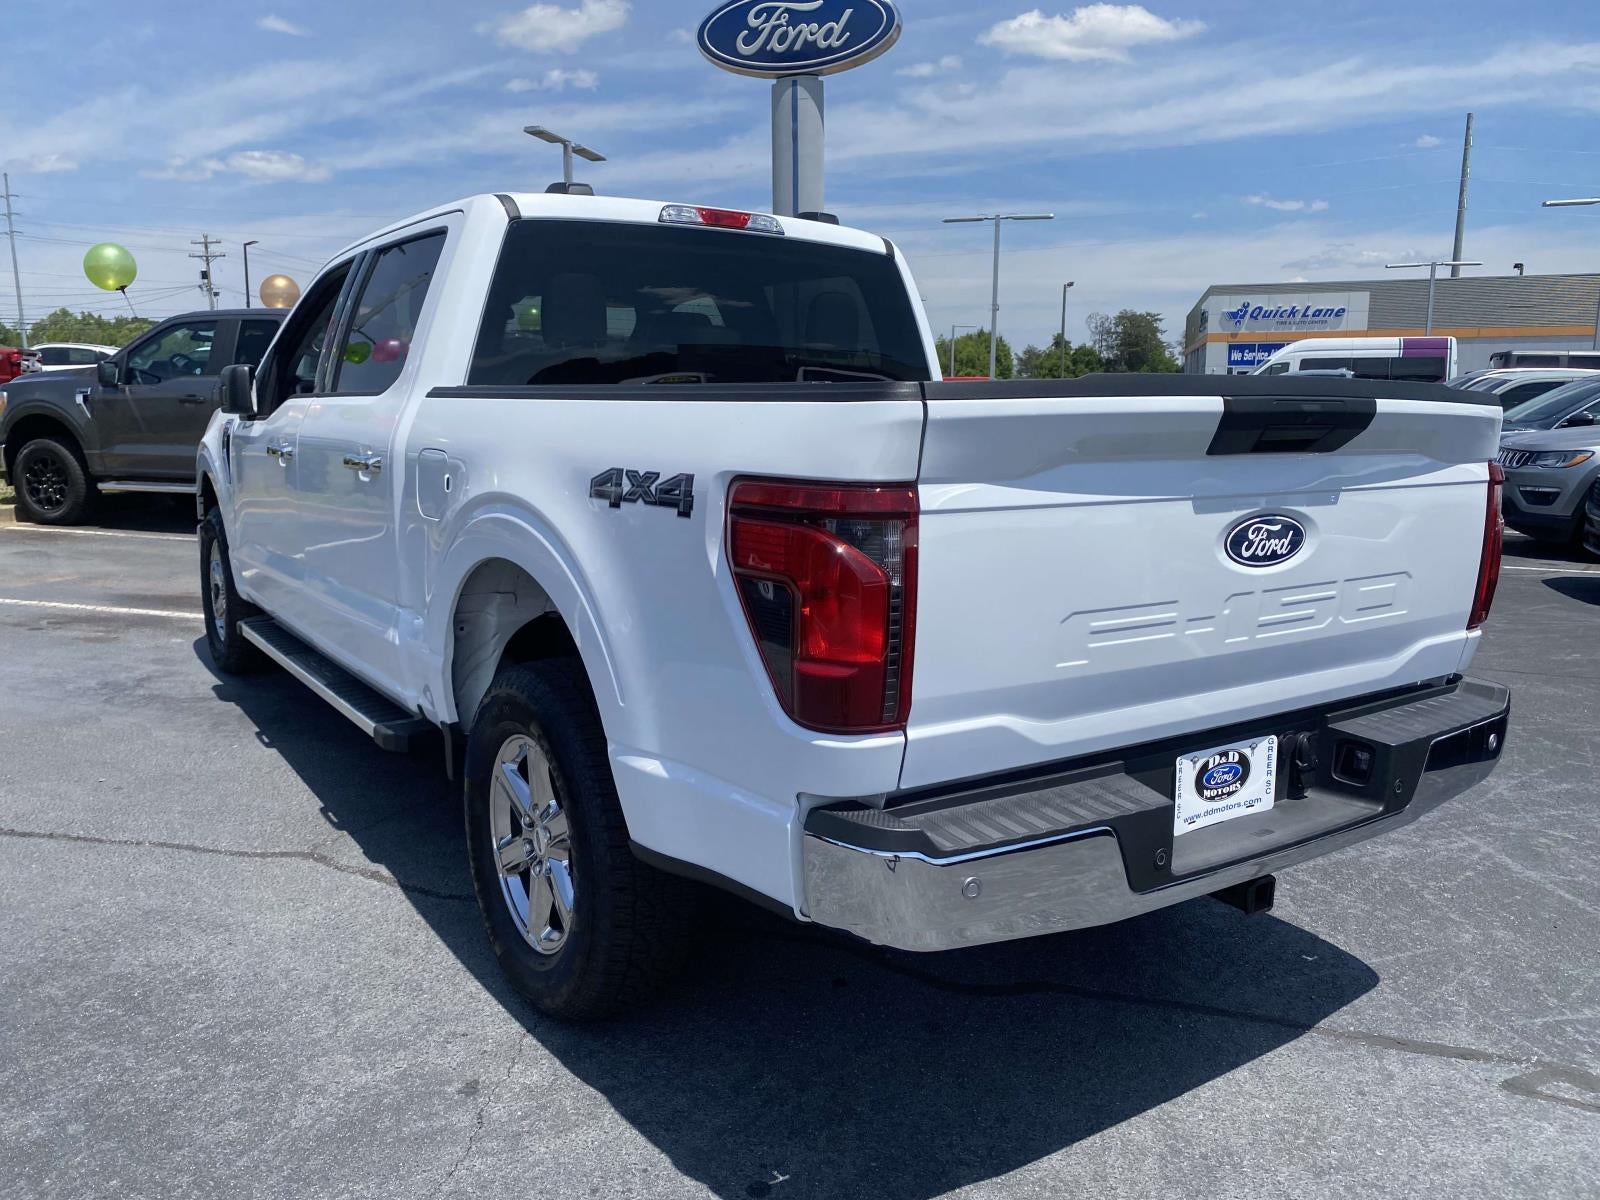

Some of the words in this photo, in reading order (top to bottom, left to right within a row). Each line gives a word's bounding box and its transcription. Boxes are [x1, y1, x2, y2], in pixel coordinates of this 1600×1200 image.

[736, 0, 853, 55] Ford
[1250, 305, 1301, 321] Quick
[1302, 305, 1346, 319] Lane
[1230, 350, 1242, 361] We
[1244, 348, 1269, 361] Service
[1241, 523, 1294, 558] Ford
[1060, 571, 1412, 667] F-150
[1208, 751, 1240, 769] D&D
[1267, 738, 1275, 777] GREER
[1210, 767, 1236, 785] Ford
[1203, 781, 1242, 799] MOTORS
[1265, 780, 1272, 795] SC
[1183, 797, 1262, 824] www.ddmotors.com
